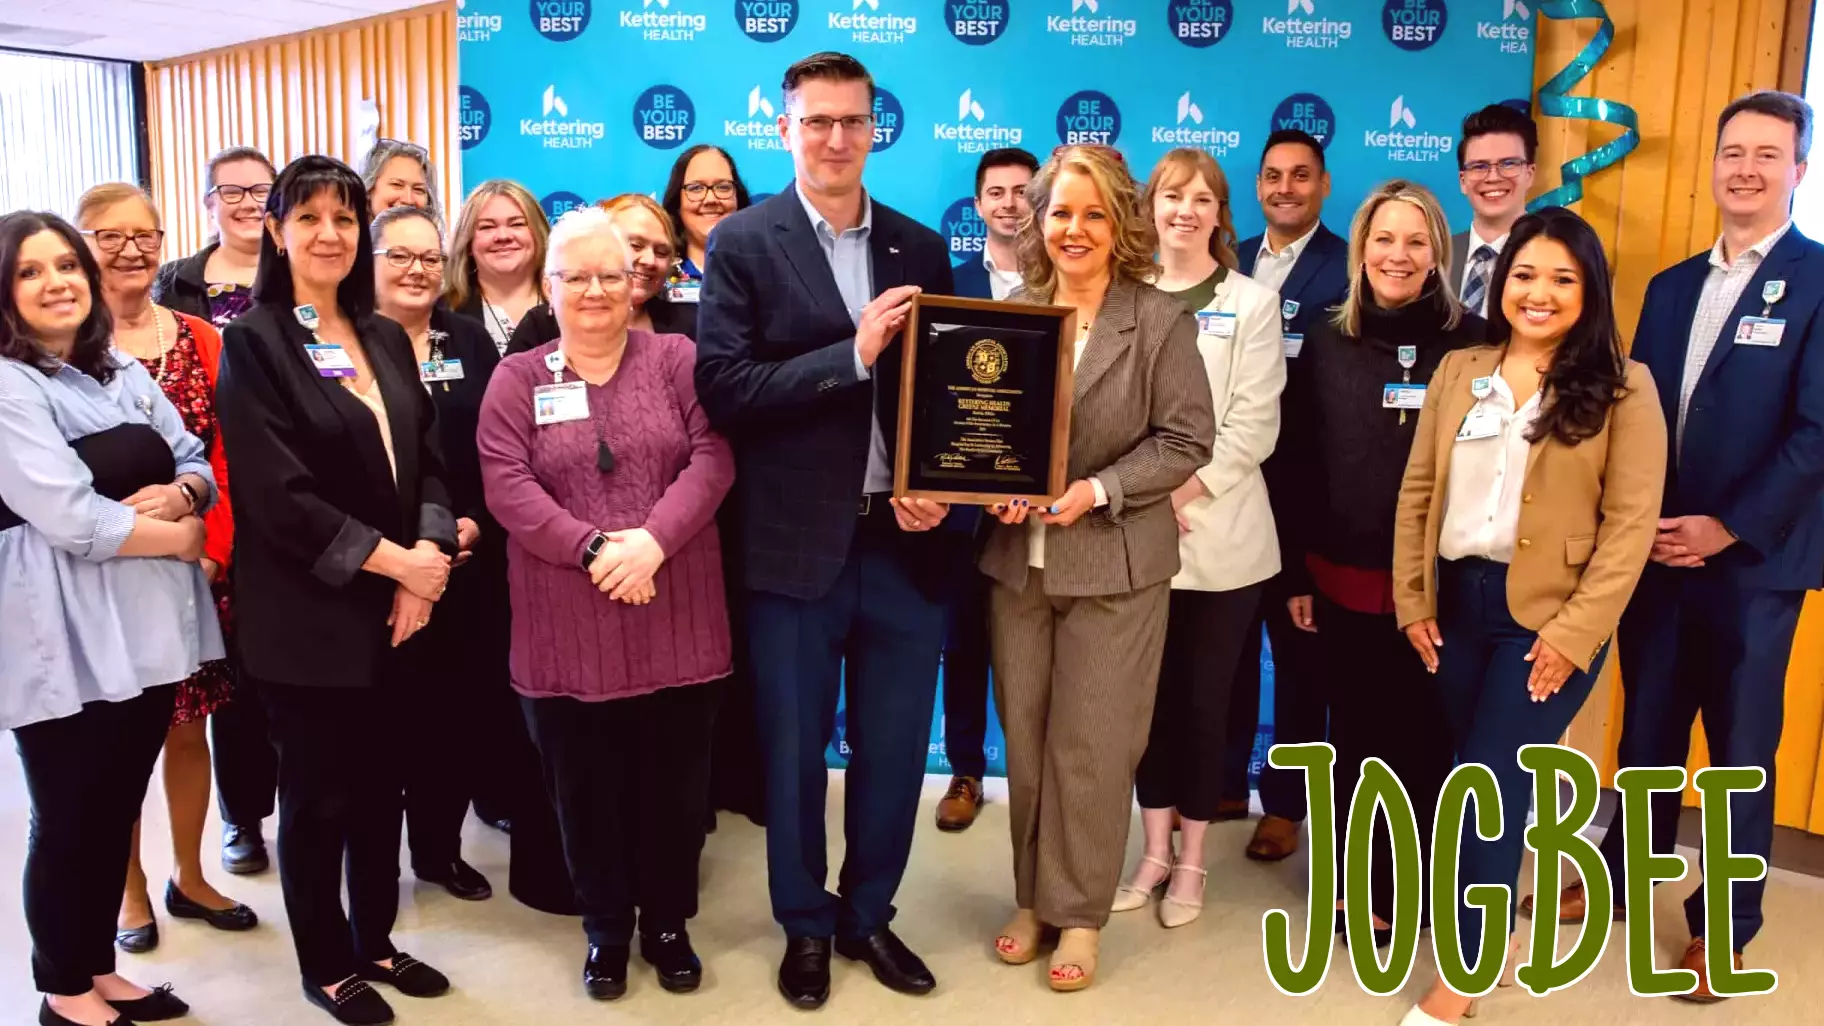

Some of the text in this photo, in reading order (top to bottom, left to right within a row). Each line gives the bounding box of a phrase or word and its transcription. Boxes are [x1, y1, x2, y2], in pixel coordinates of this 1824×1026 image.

[536, 1, 585, 16] YOUR
[742, 2, 792, 18] YOUR
[952, 5, 1003, 20] YOUR
[1175, 6, 1225, 22] YOUR
[540, 16, 582, 32] BEST
[619, 11, 706, 31] Kettering
[745, 17, 789, 33] BEST
[828, 12, 916, 34] Kettering
[1389, 9, 1440, 25] YOUR
[955, 20, 999, 36] BEST
[1047, 15, 1136, 37] Kettering
[1178, 22, 1222, 38] BEST
[1262, 16, 1352, 39] Kettering
[1391, 25, 1437, 41] BEST
[1477, 21, 1529, 39] Kette
[643, 29, 695, 41] HEALTH
[852, 31, 904, 44] HEALTH
[1071, 34, 1123, 46] HEALTH
[1286, 36, 1338, 48] HEALTH
[1500, 41, 1528, 54] HEA
[653, 94, 675, 109] BE
[1078, 100, 1101, 115] BE
[459, 110, 485, 125] UR
[640, 109, 689, 125] YOUR
[1294, 102, 1315, 118] BE
[520, 119, 604, 139] Kettering
[1064, 115, 1114, 131] YOUR
[1278, 117, 1329, 134] YOUR
[643, 125, 686, 141] BEST
[934, 123, 1022, 144] Kettering
[1067, 131, 1110, 145] BEST
[1152, 126, 1240, 148] Kettering
[1364, 130, 1453, 152] Kettering
[543, 137, 593, 149] HEALTH
[1388, 149, 1440, 162] HEALTH
[951, 236, 987, 252] BES
